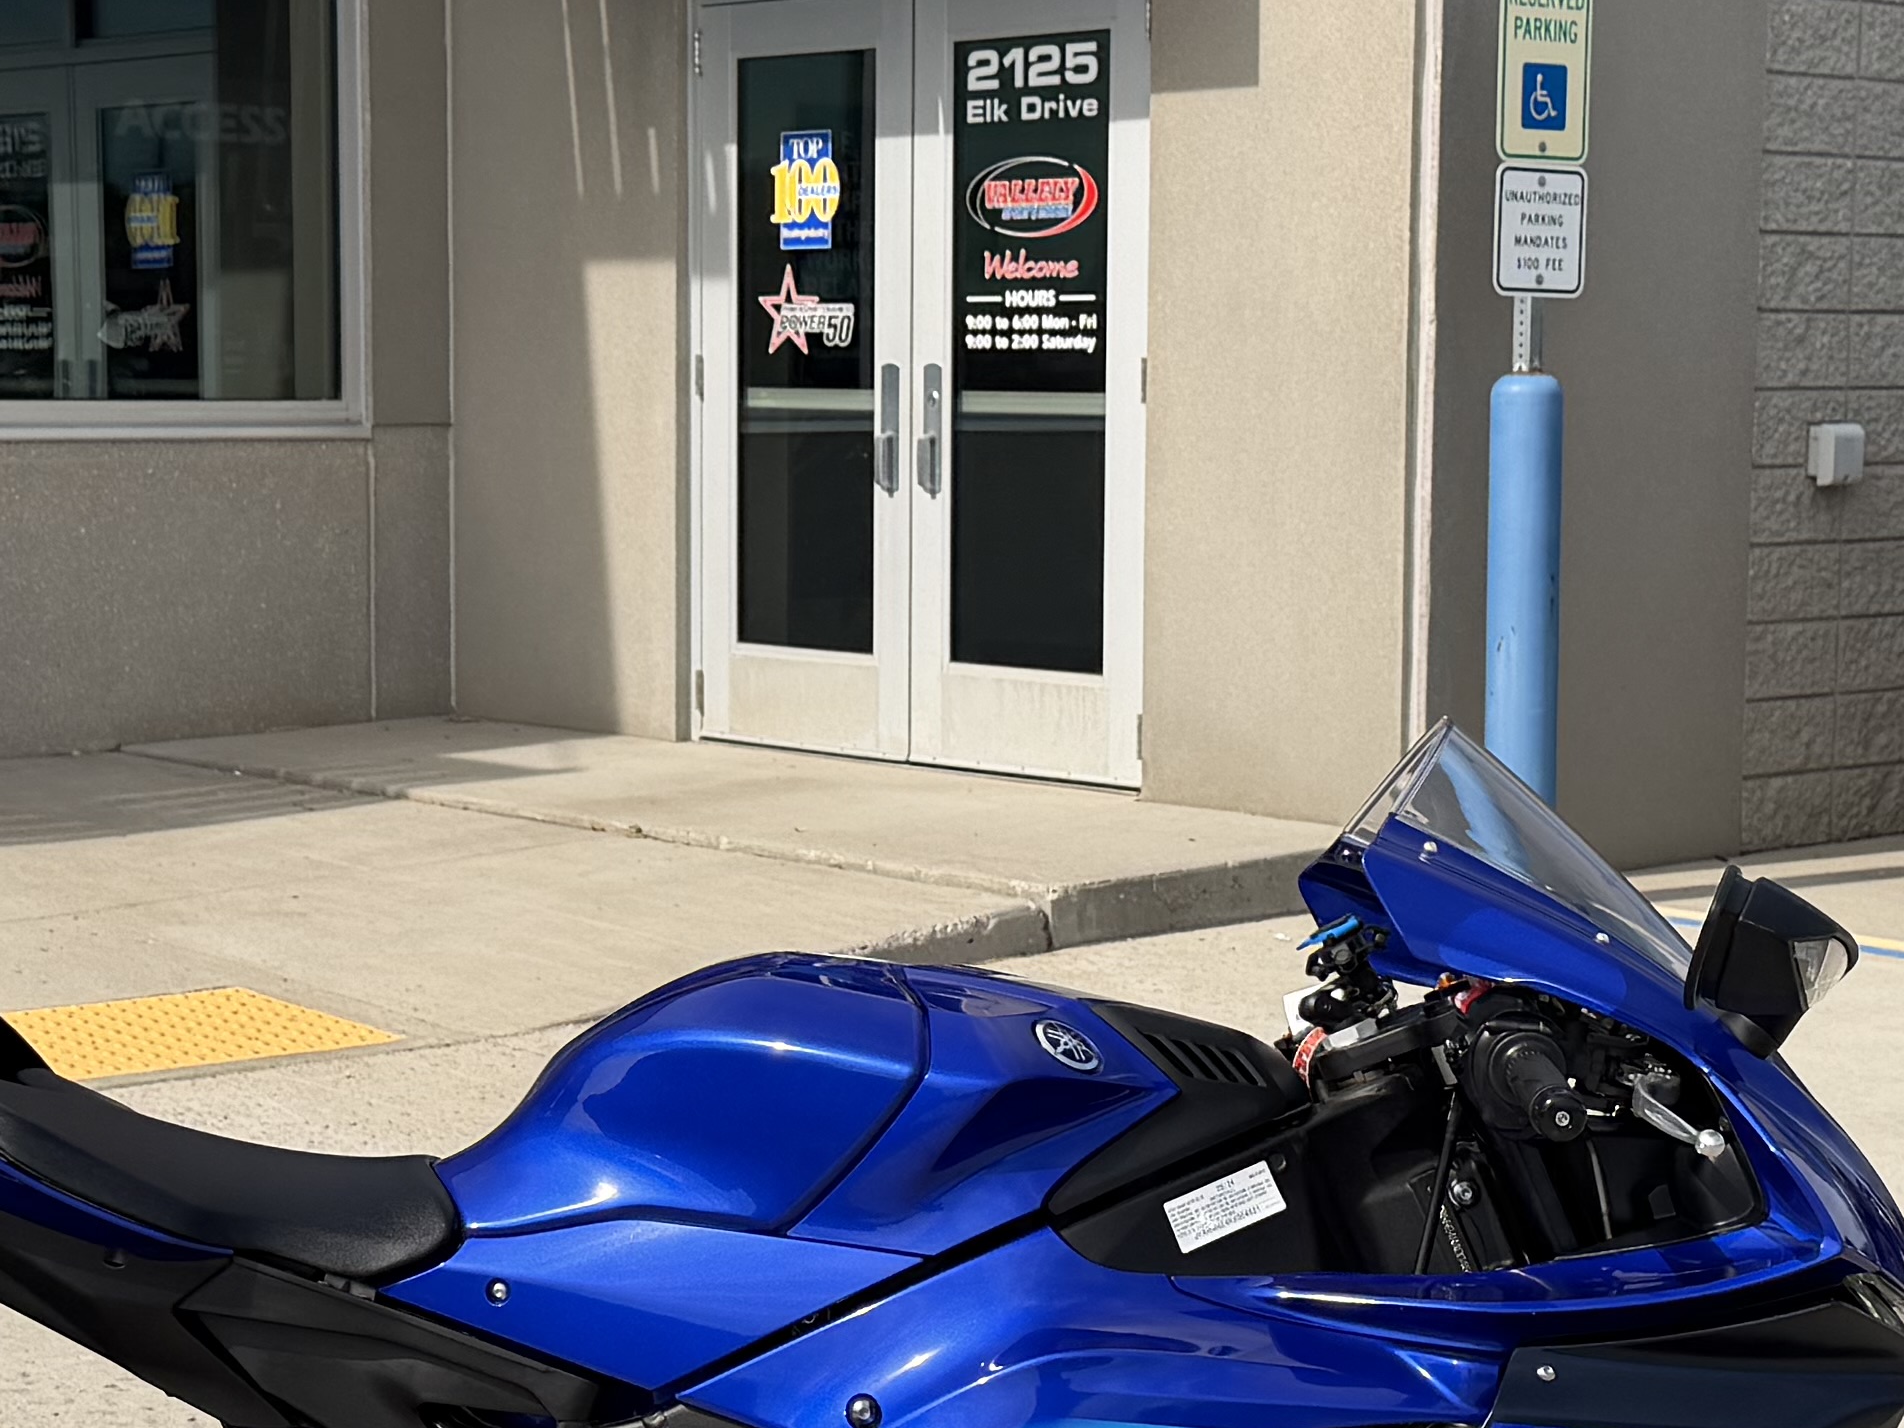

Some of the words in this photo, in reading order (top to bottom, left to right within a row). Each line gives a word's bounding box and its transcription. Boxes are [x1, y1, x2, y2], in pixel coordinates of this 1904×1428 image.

[1513, 16, 1578, 45] PARKING
[967, 41, 1099, 92] 2125
[966, 97, 1009, 124] Elk
[1020, 93, 1099, 121] Drive
[789, 137, 823, 159] TOP
[770, 157, 840, 224] 100
[1504, 190, 1580, 207] UNAUTHORIZED
[1520, 212, 1564, 227] PARKING
[1514, 235, 1568, 250] MANDATES
[983, 248, 1080, 280] Welcome
[1545, 258, 1564, 271] FEE
[1004, 289, 1057, 308] HOURS
[825, 314, 852, 344] 50
[995, 316, 1009, 330] to
[1041, 314, 1069, 330] Mon
[1079, 313, 1097, 330] Fri
[995, 335, 1009, 350] to
[1041, 334, 1097, 354] Saturday
